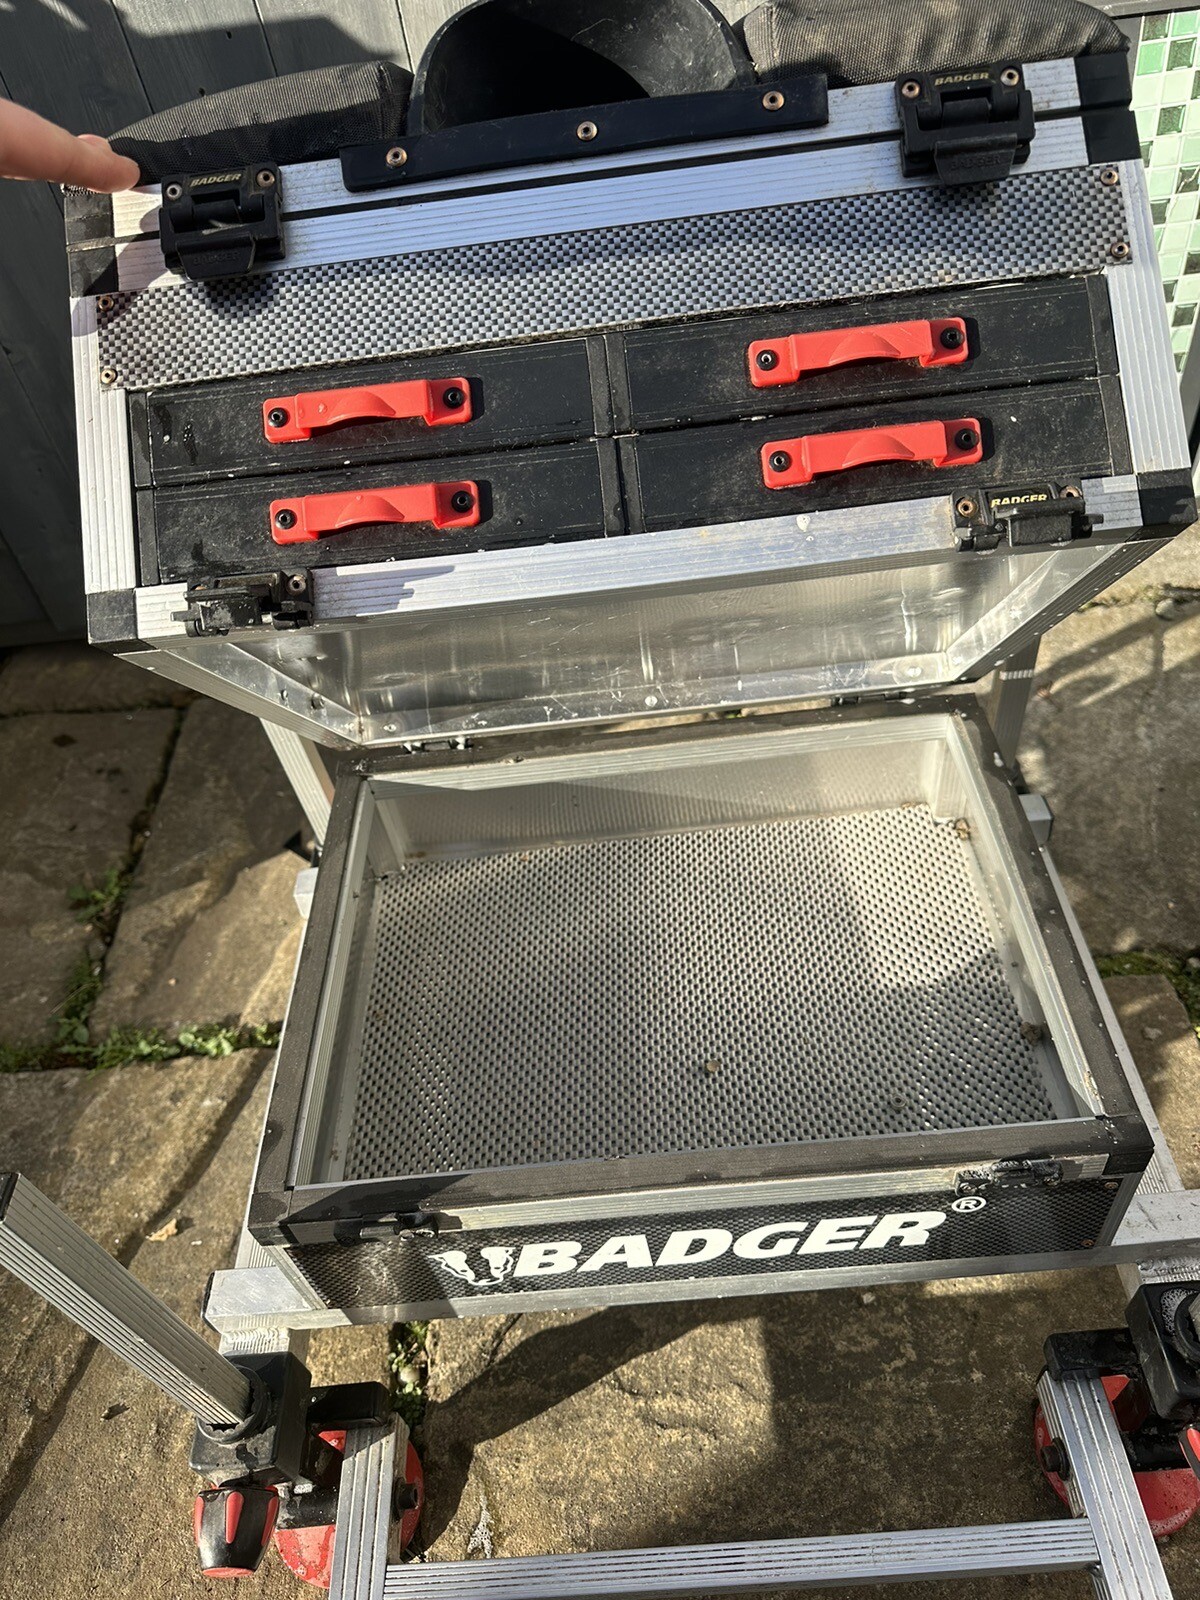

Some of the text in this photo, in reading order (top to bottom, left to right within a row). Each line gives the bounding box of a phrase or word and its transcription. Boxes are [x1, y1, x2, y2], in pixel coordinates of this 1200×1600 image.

[934, 72, 990, 87] BADGER
[190, 173, 242, 188] BADGER
[513, 1210, 947, 1278] BADGER
